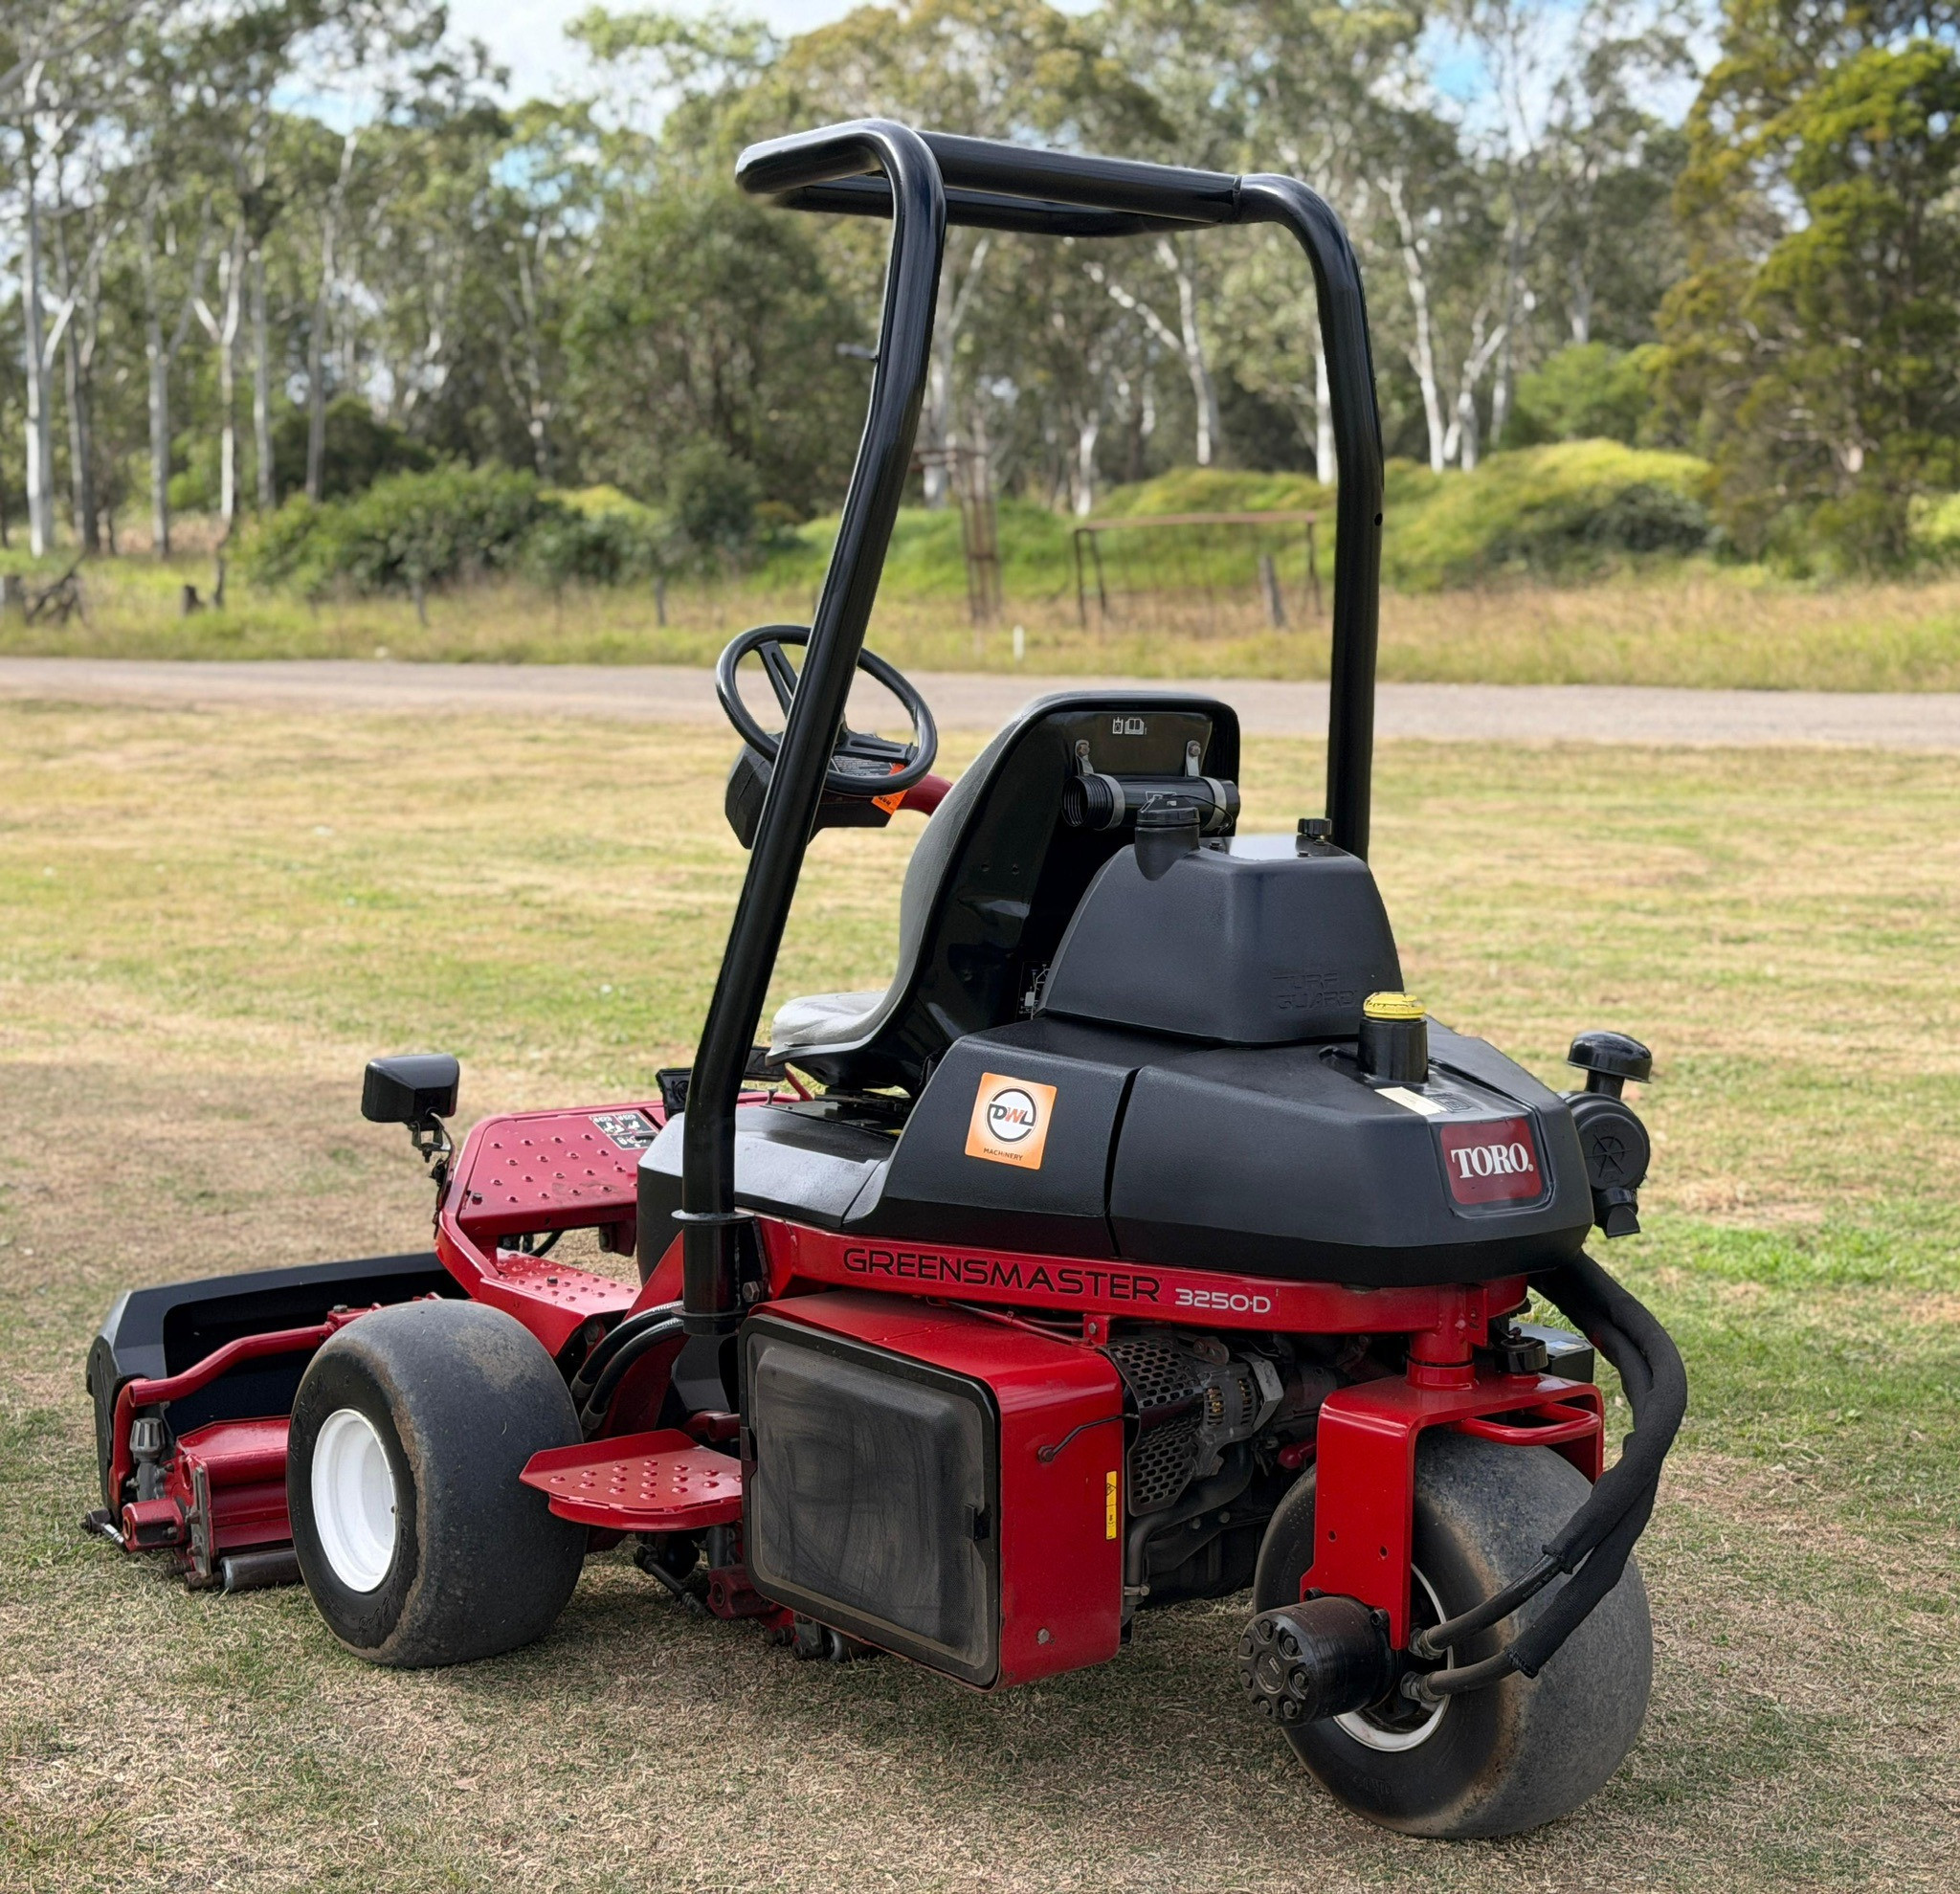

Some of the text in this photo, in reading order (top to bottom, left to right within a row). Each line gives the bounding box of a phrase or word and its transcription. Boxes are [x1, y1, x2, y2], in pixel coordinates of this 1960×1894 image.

[991, 1104, 1035, 1126] DWL
[983, 1147, 1024, 1161] MACHINERY
[843, 1247, 1161, 1303] GREENSMASTER
